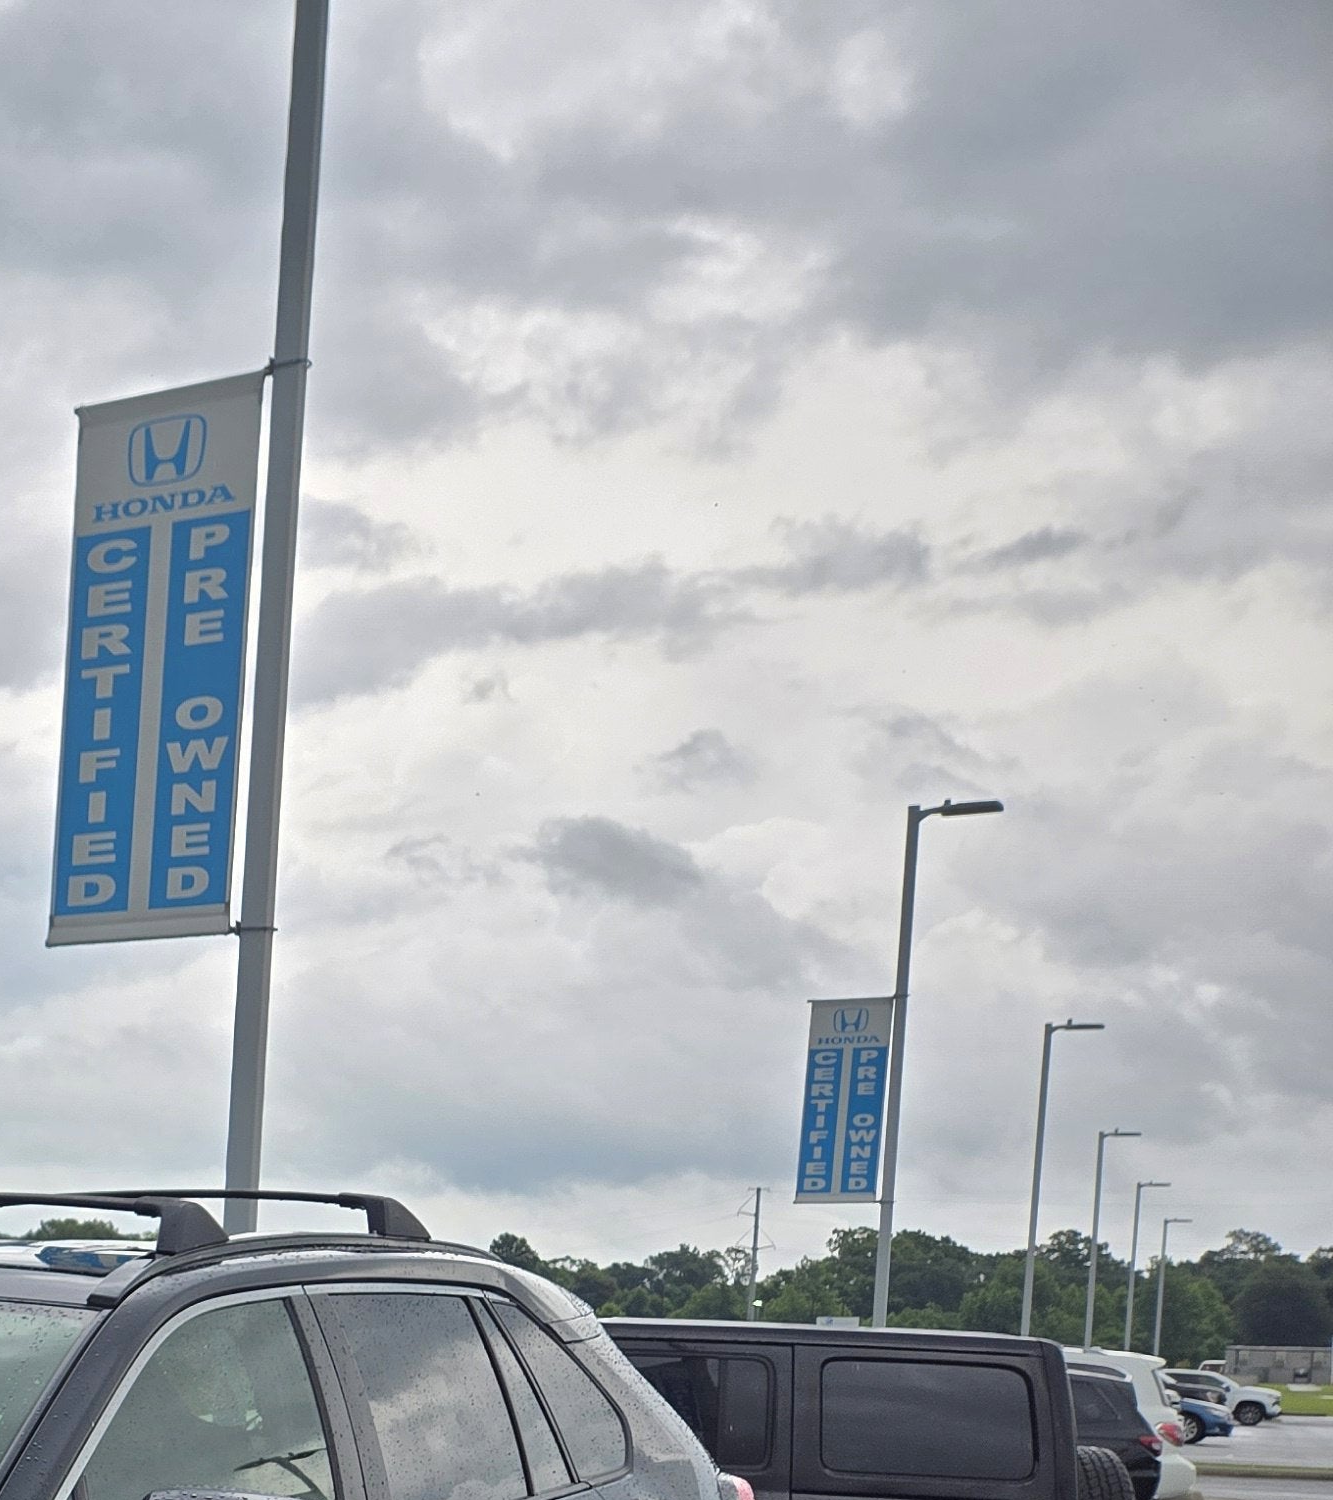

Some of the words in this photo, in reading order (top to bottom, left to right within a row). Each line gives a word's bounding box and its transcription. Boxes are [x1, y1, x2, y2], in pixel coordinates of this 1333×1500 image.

[91, 483, 236, 524] HONDA
[183, 523, 231, 647] PRE
[66, 538, 138, 908] CERTIFIED
[165, 694, 229, 901] OWNED
[818, 1036, 880, 1044] HONDA
[856, 1050, 879, 1096] PRE
[802, 1051, 838, 1192] CERTIFIED
[848, 1113, 877, 1192] OWNED
